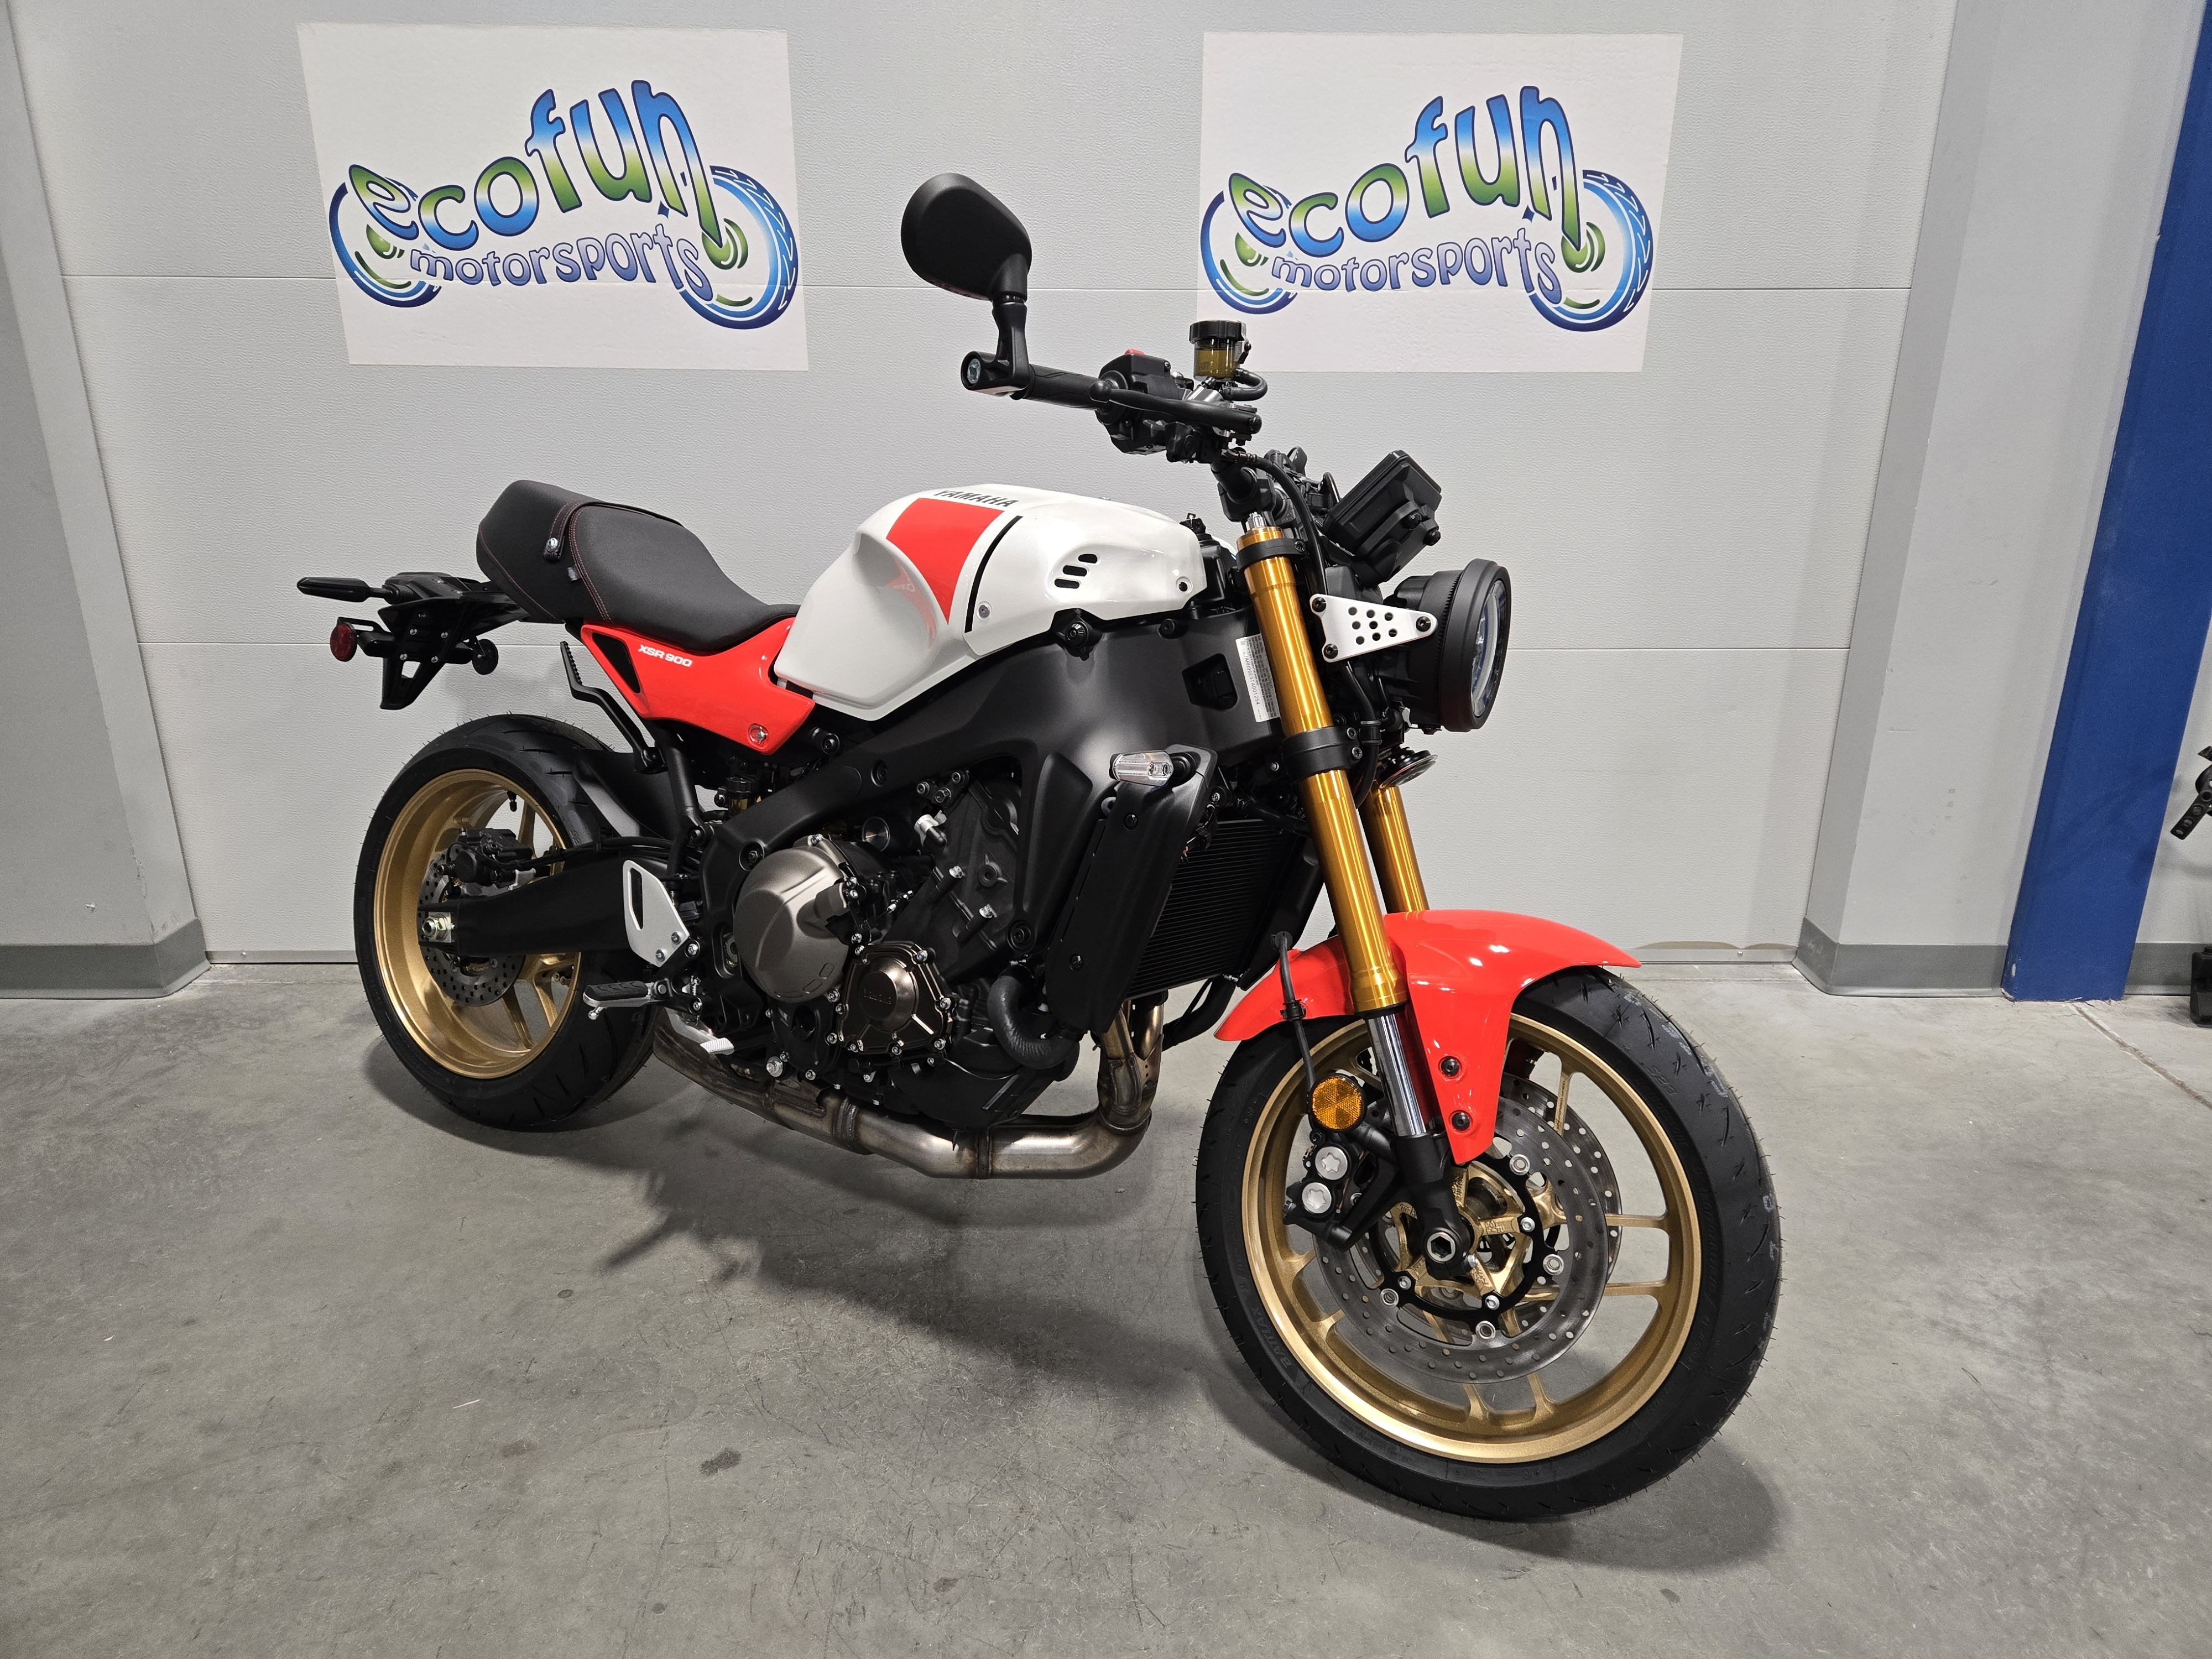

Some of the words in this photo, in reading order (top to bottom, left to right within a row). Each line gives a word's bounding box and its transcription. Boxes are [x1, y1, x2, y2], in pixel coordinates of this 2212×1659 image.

[348, 80, 723, 248] ecofun
[1228, 85, 1582, 252] ecofun
[409, 223, 714, 302] motorsports
[1271, 227, 1563, 305] motorsports
[933, 490, 1019, 507] YAMAHA
[638, 644, 665, 659] XSR
[665, 653, 692, 667] 900
